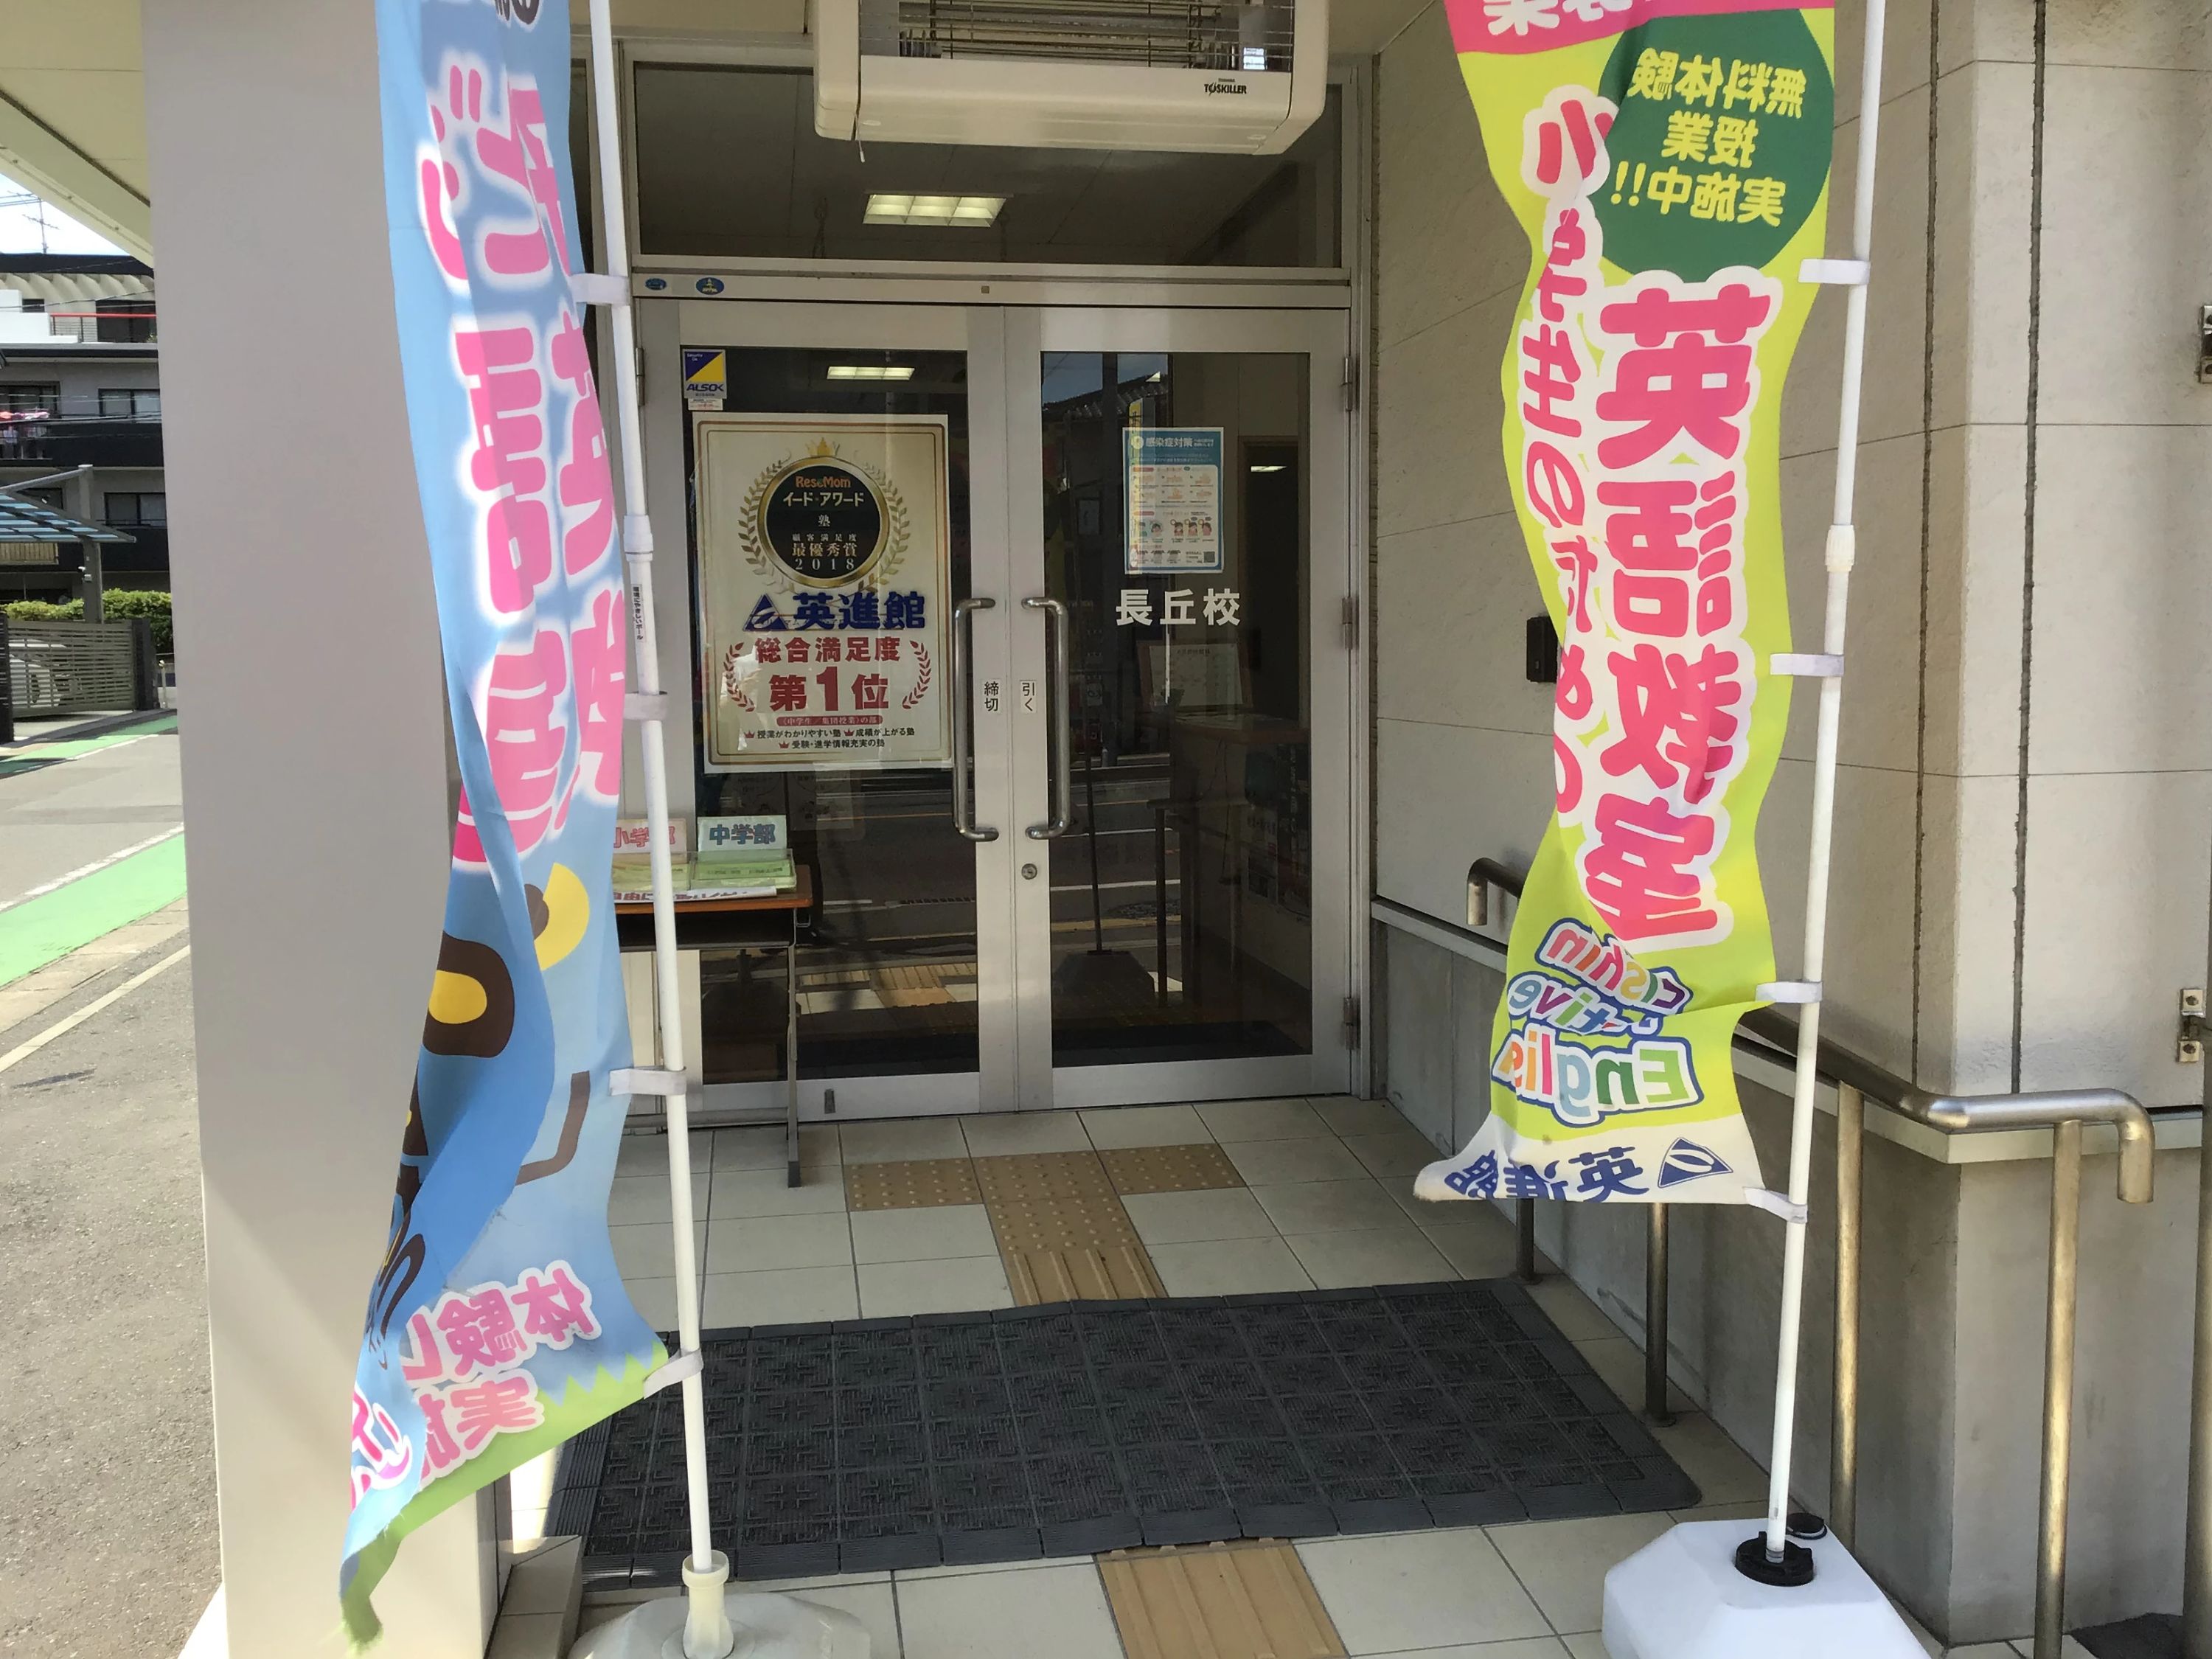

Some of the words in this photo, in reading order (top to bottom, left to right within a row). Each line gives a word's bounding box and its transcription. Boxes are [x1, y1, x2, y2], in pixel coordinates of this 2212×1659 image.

[686, 383, 724, 392] ALSOK
[783, 492, 864, 507] イード・アワード
[818, 514, 831, 527] 塾
[792, 542, 858, 557] 最優秀賞
[795, 558, 855, 571] 2018
[793, 591, 925, 630] 英進館
[1116, 588, 1240, 626] 長丘校
[755, 636, 900, 663] 総合満足度
[769, 667, 888, 712] 第1位
[984, 681, 999, 712] 締切
[1022, 682, 1034, 712] 引く
[709, 824, 776, 845] 中学部
